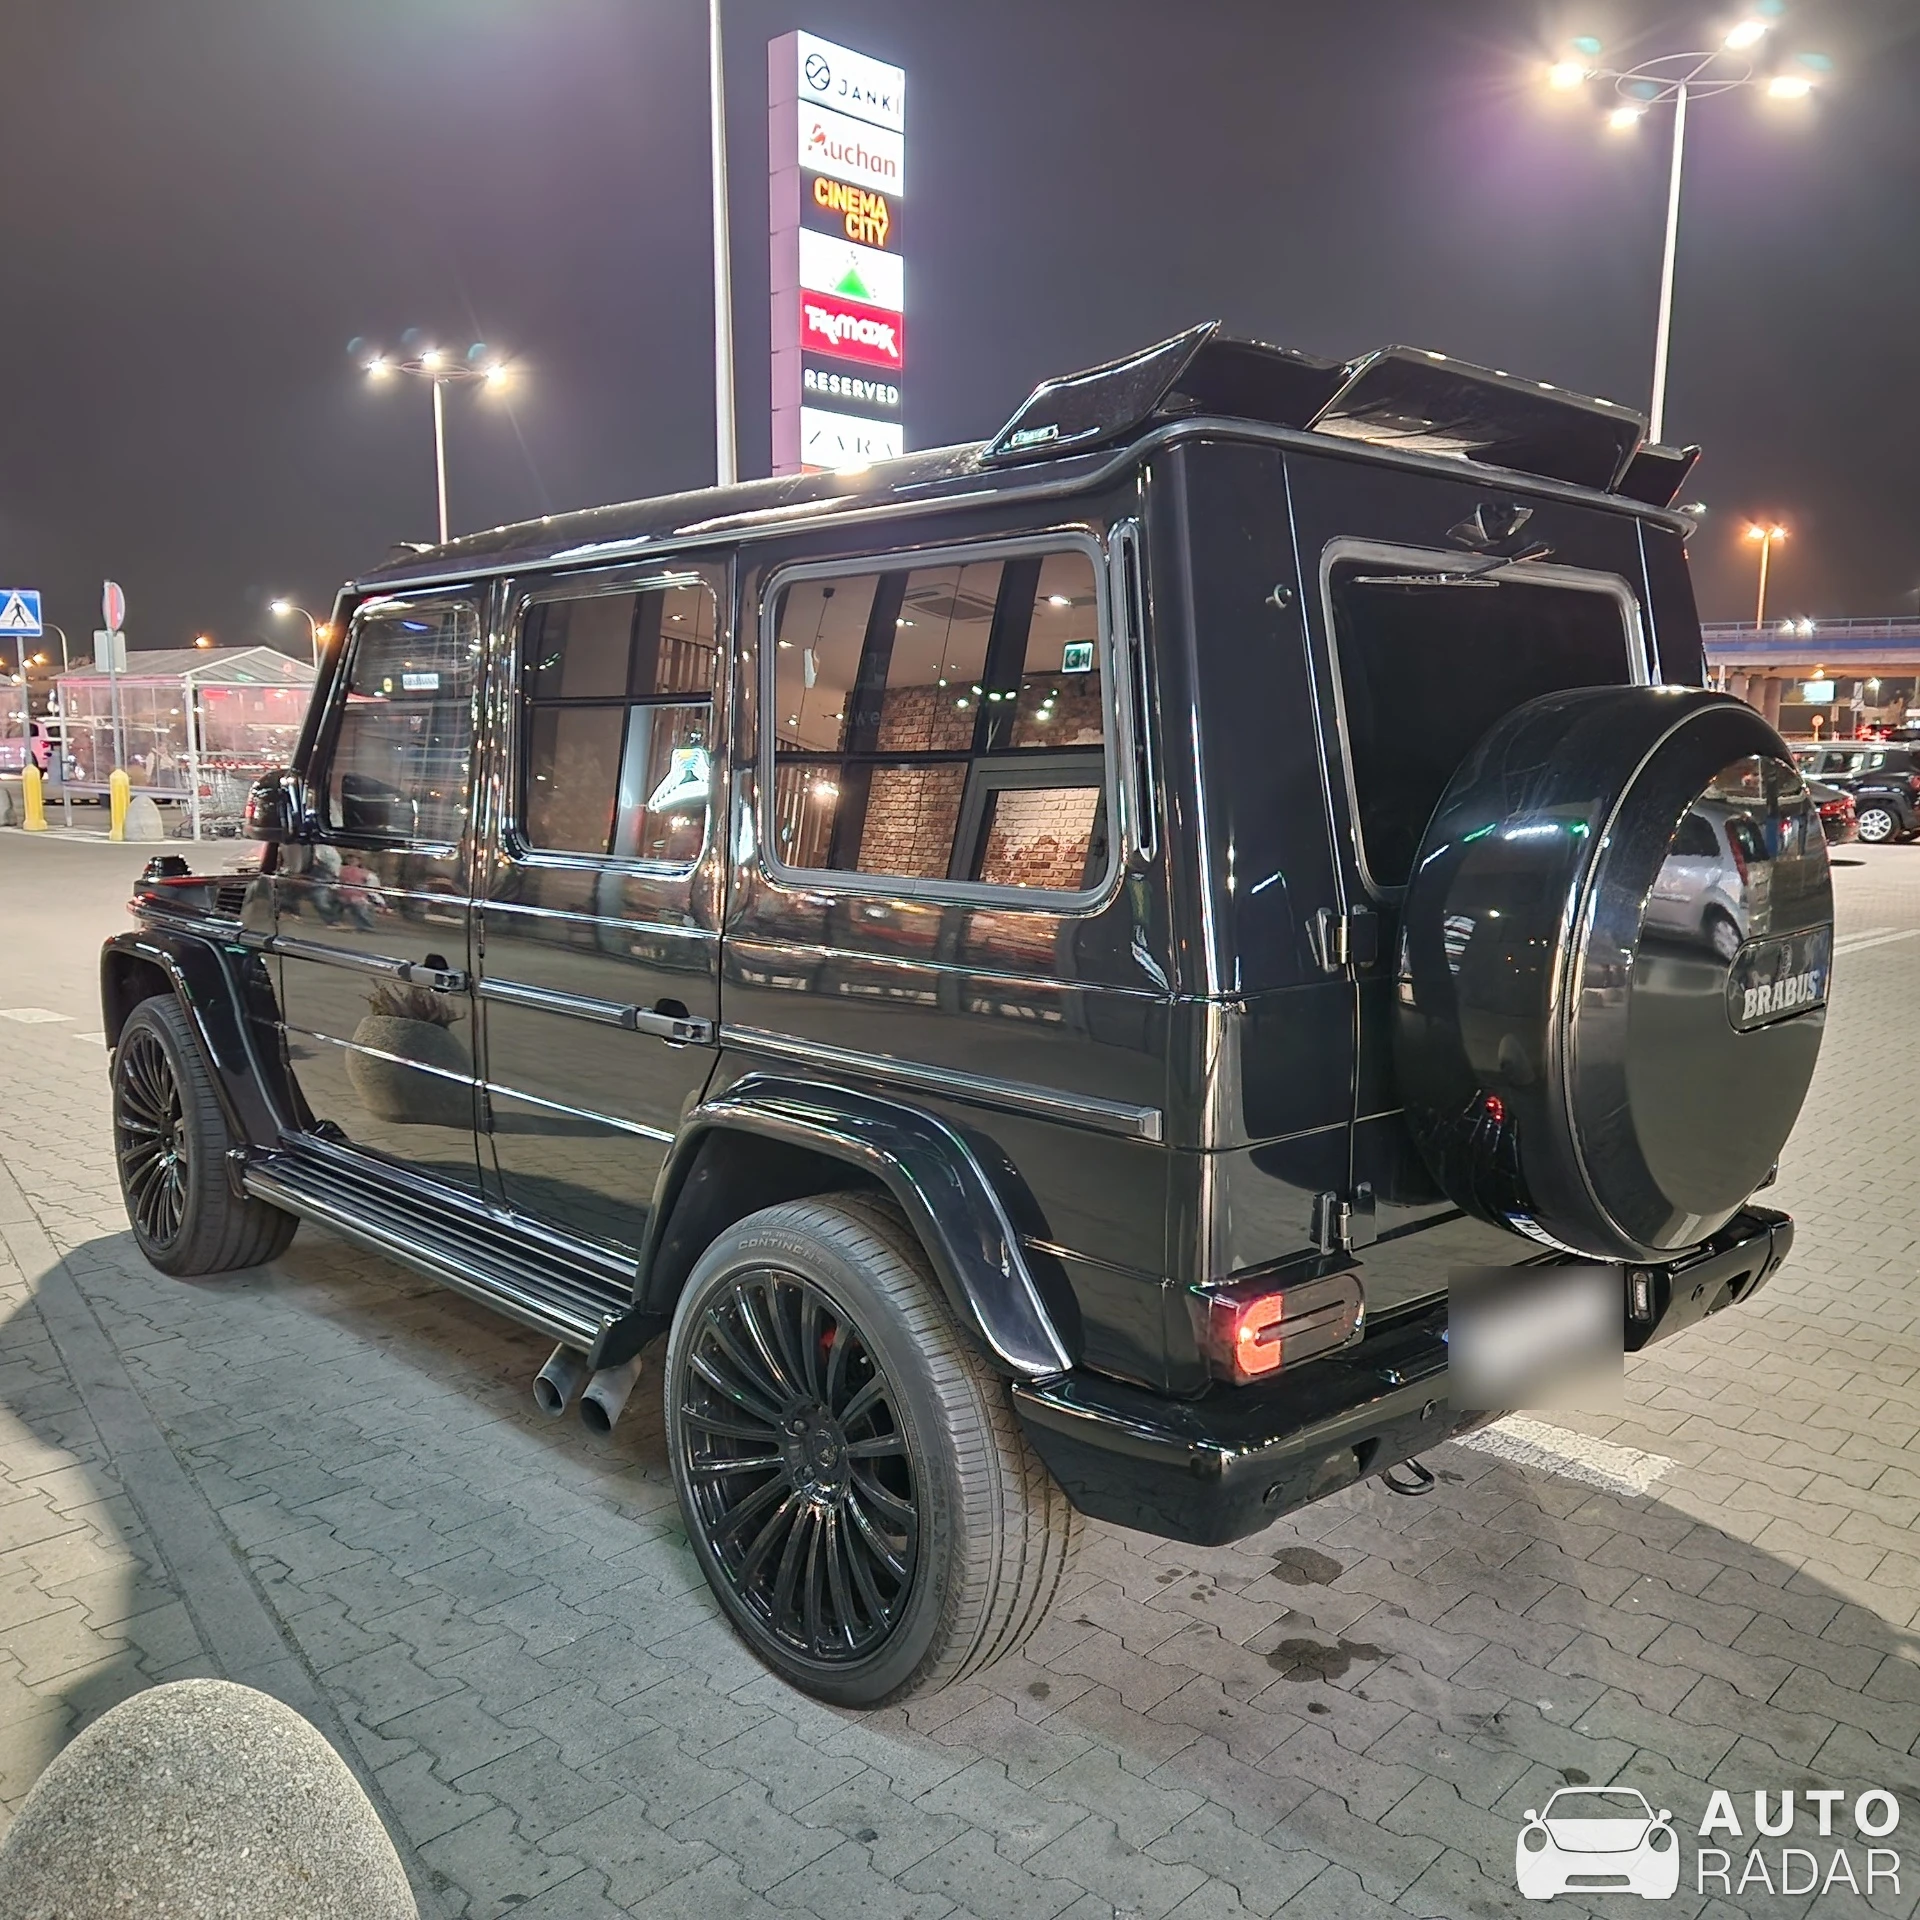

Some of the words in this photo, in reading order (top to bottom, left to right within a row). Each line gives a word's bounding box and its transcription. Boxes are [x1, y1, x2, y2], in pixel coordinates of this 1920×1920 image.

[838, 79, 900, 115] JANKI
[808, 123, 896, 178] Auchan
[813, 176, 889, 222] CINEMA
[845, 212, 889, 246] CITY
[804, 368, 899, 404] RESERVED
[1742, 970, 1820, 1020] BRABUS
